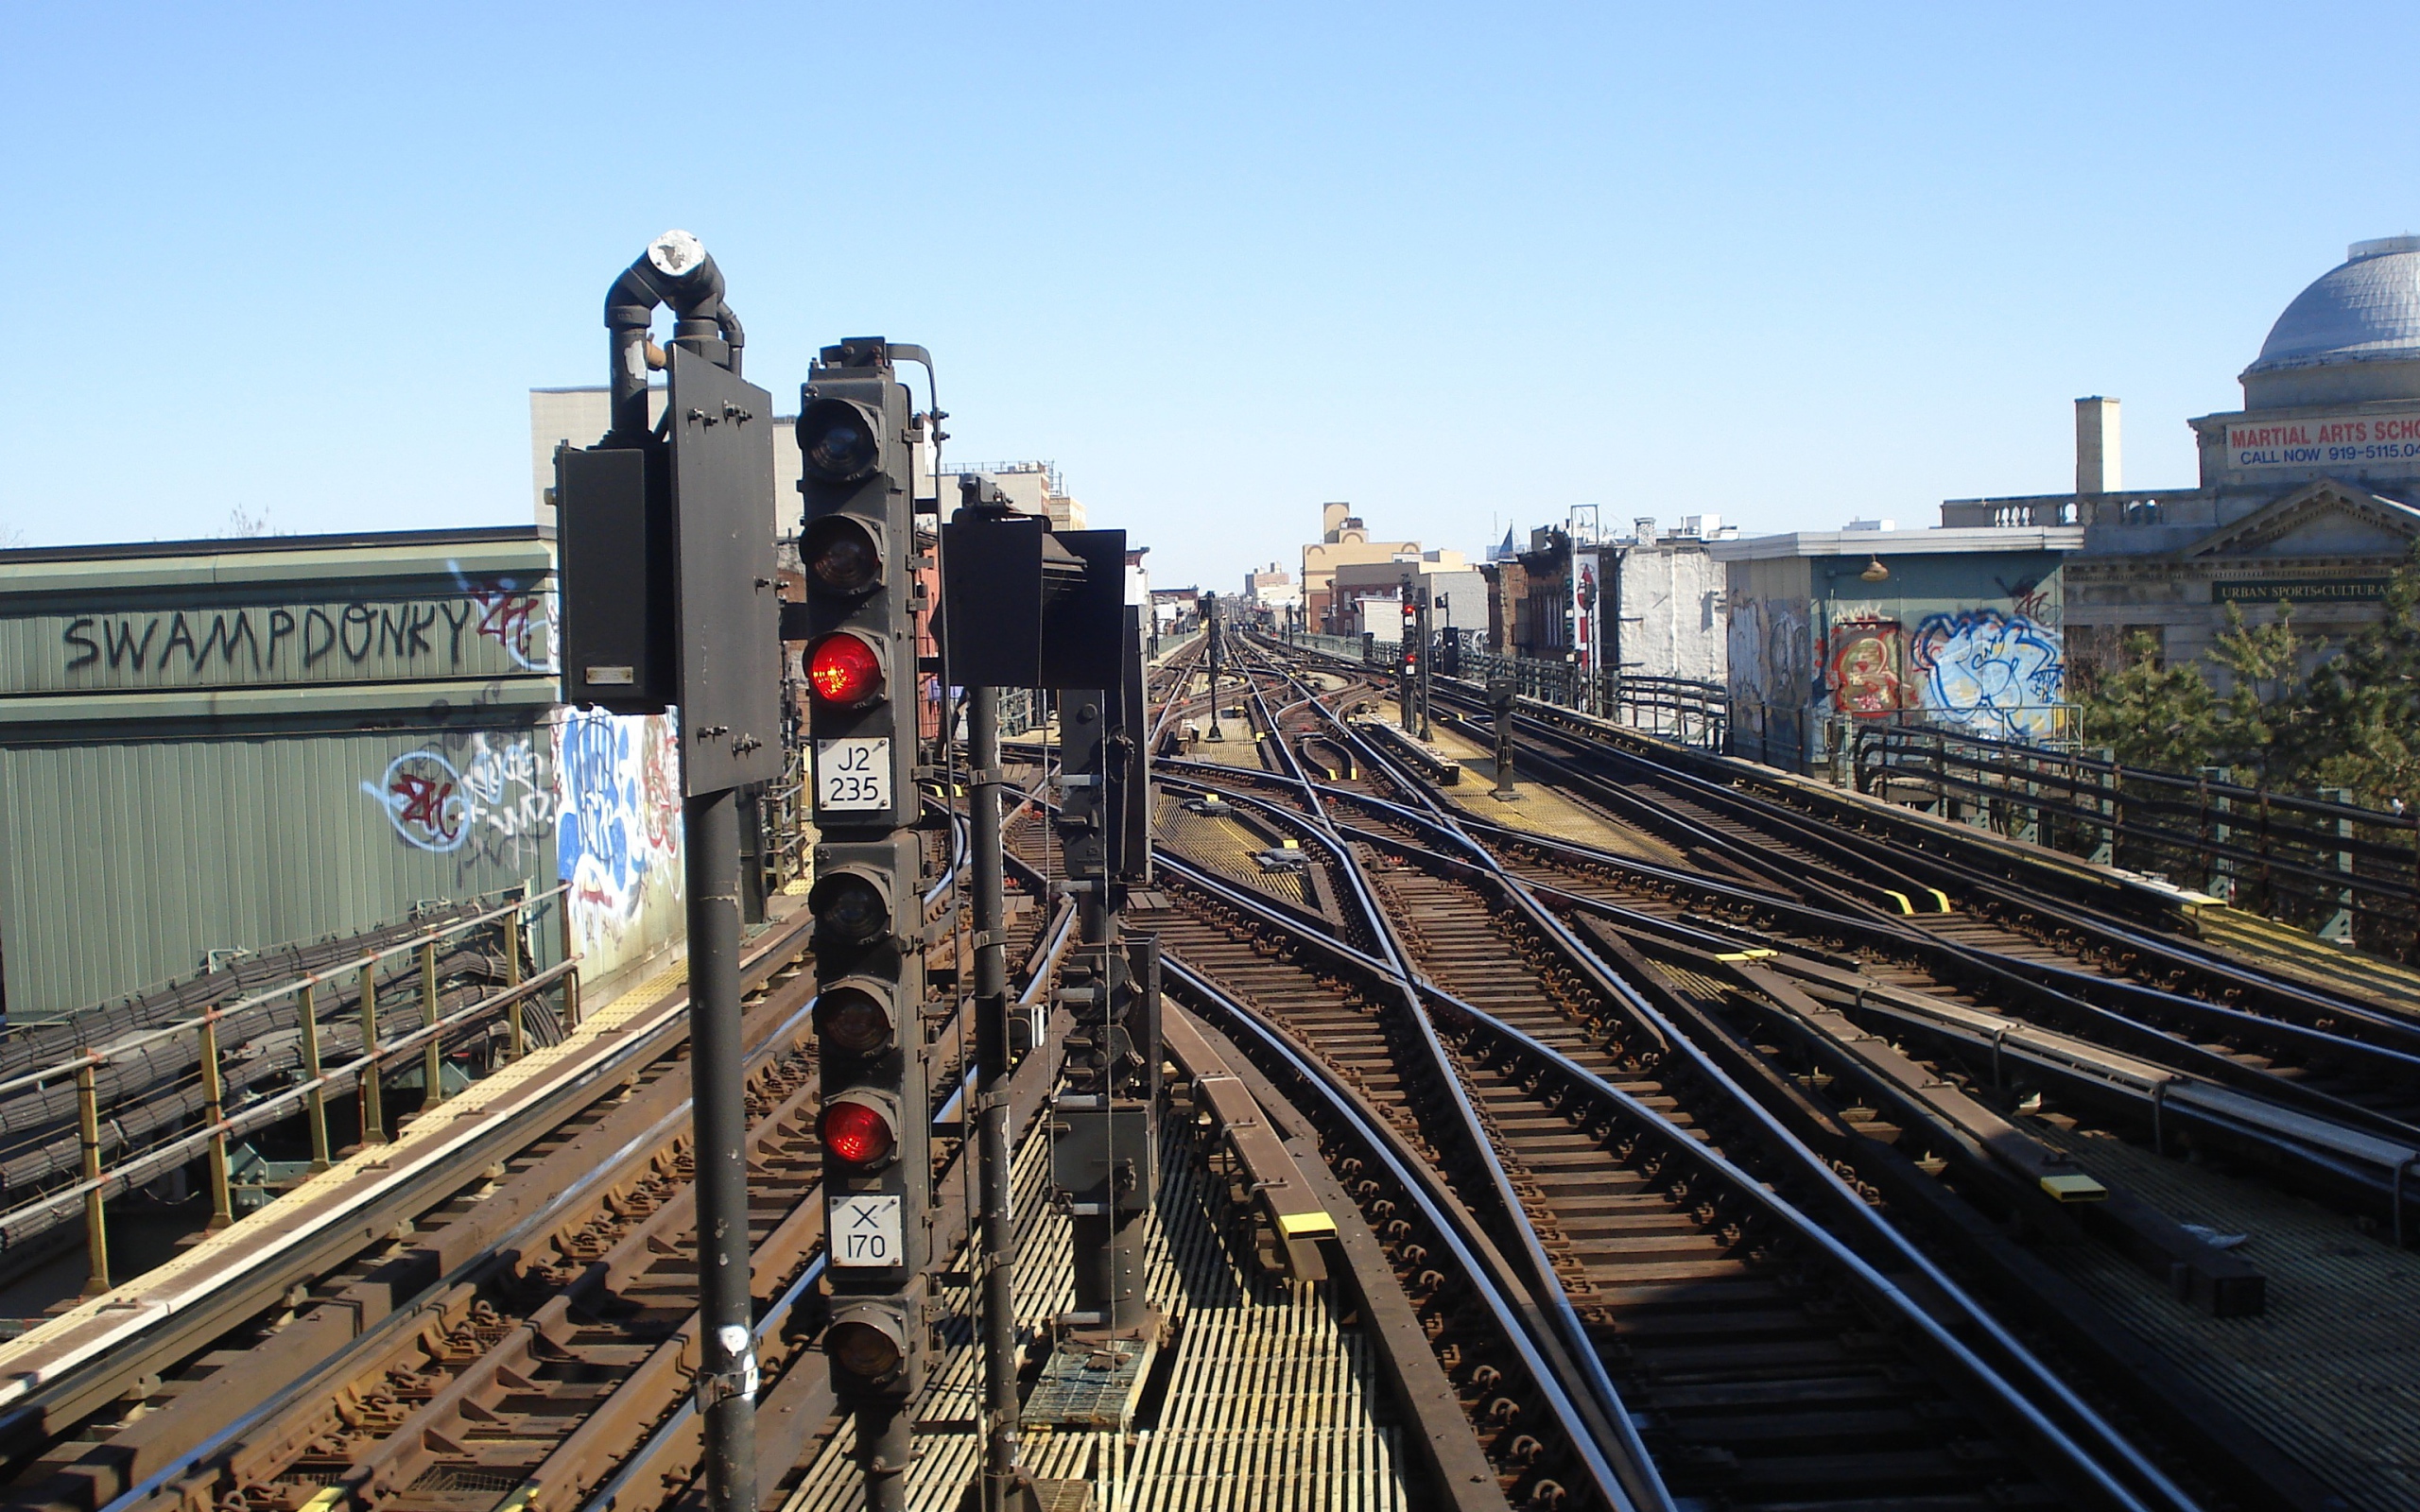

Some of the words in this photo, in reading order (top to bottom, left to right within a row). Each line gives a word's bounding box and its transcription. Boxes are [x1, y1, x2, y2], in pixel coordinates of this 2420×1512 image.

[2231, 425, 2311, 449] MARTIAL
[2318, 421, 2367, 444] ARTS
[2240, 450, 2280, 465] CALL
[2283, 447, 2321, 463] NOW
[2221, 586, 2267, 598] URBAN
[2322, 584, 2392, 596] CULTURA
[62, 600, 471, 674] SWAMPDONKY
[838, 747, 871, 771] J2
[830, 777, 879, 801] 235
[851, 1204, 879, 1228] X
[847, 1234, 886, 1259] 170
